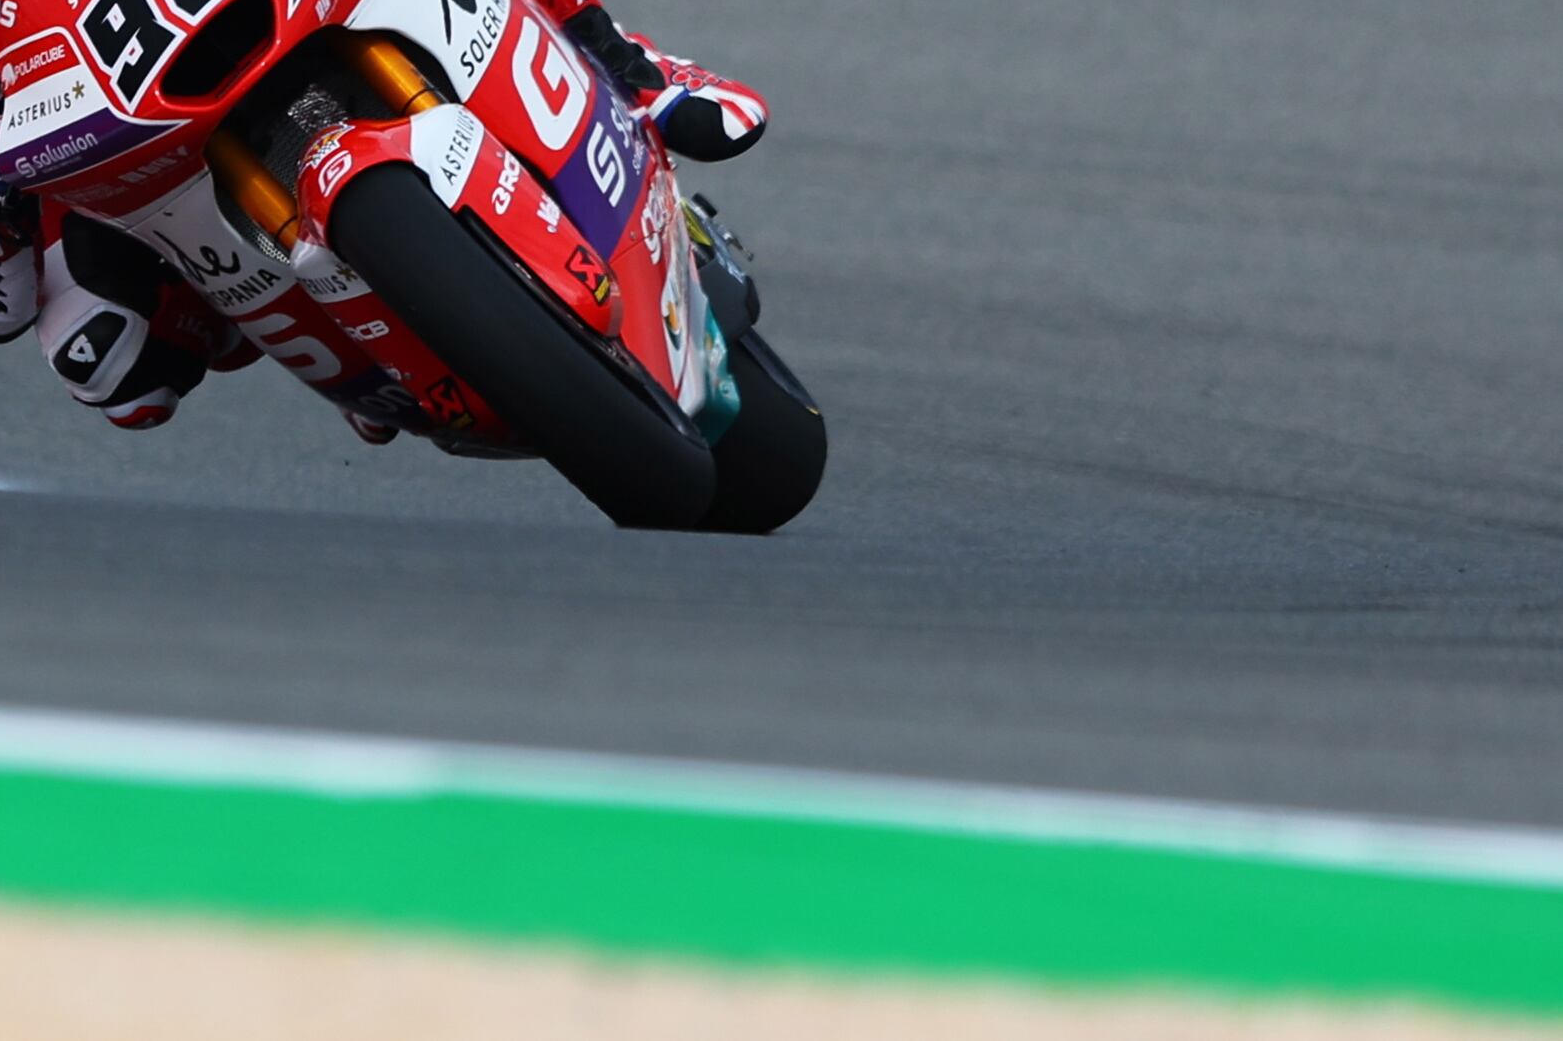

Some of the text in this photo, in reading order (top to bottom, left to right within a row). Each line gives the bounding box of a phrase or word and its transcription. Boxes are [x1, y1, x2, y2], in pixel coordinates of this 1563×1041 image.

[14, 44, 66, 76] POLARCUBE
[460, 6, 503, 77] SOLER
[7, 93, 72, 130] ASTERIUS
[32, 132, 98, 169] solunion
[440, 110, 476, 186] ASTERIUS
